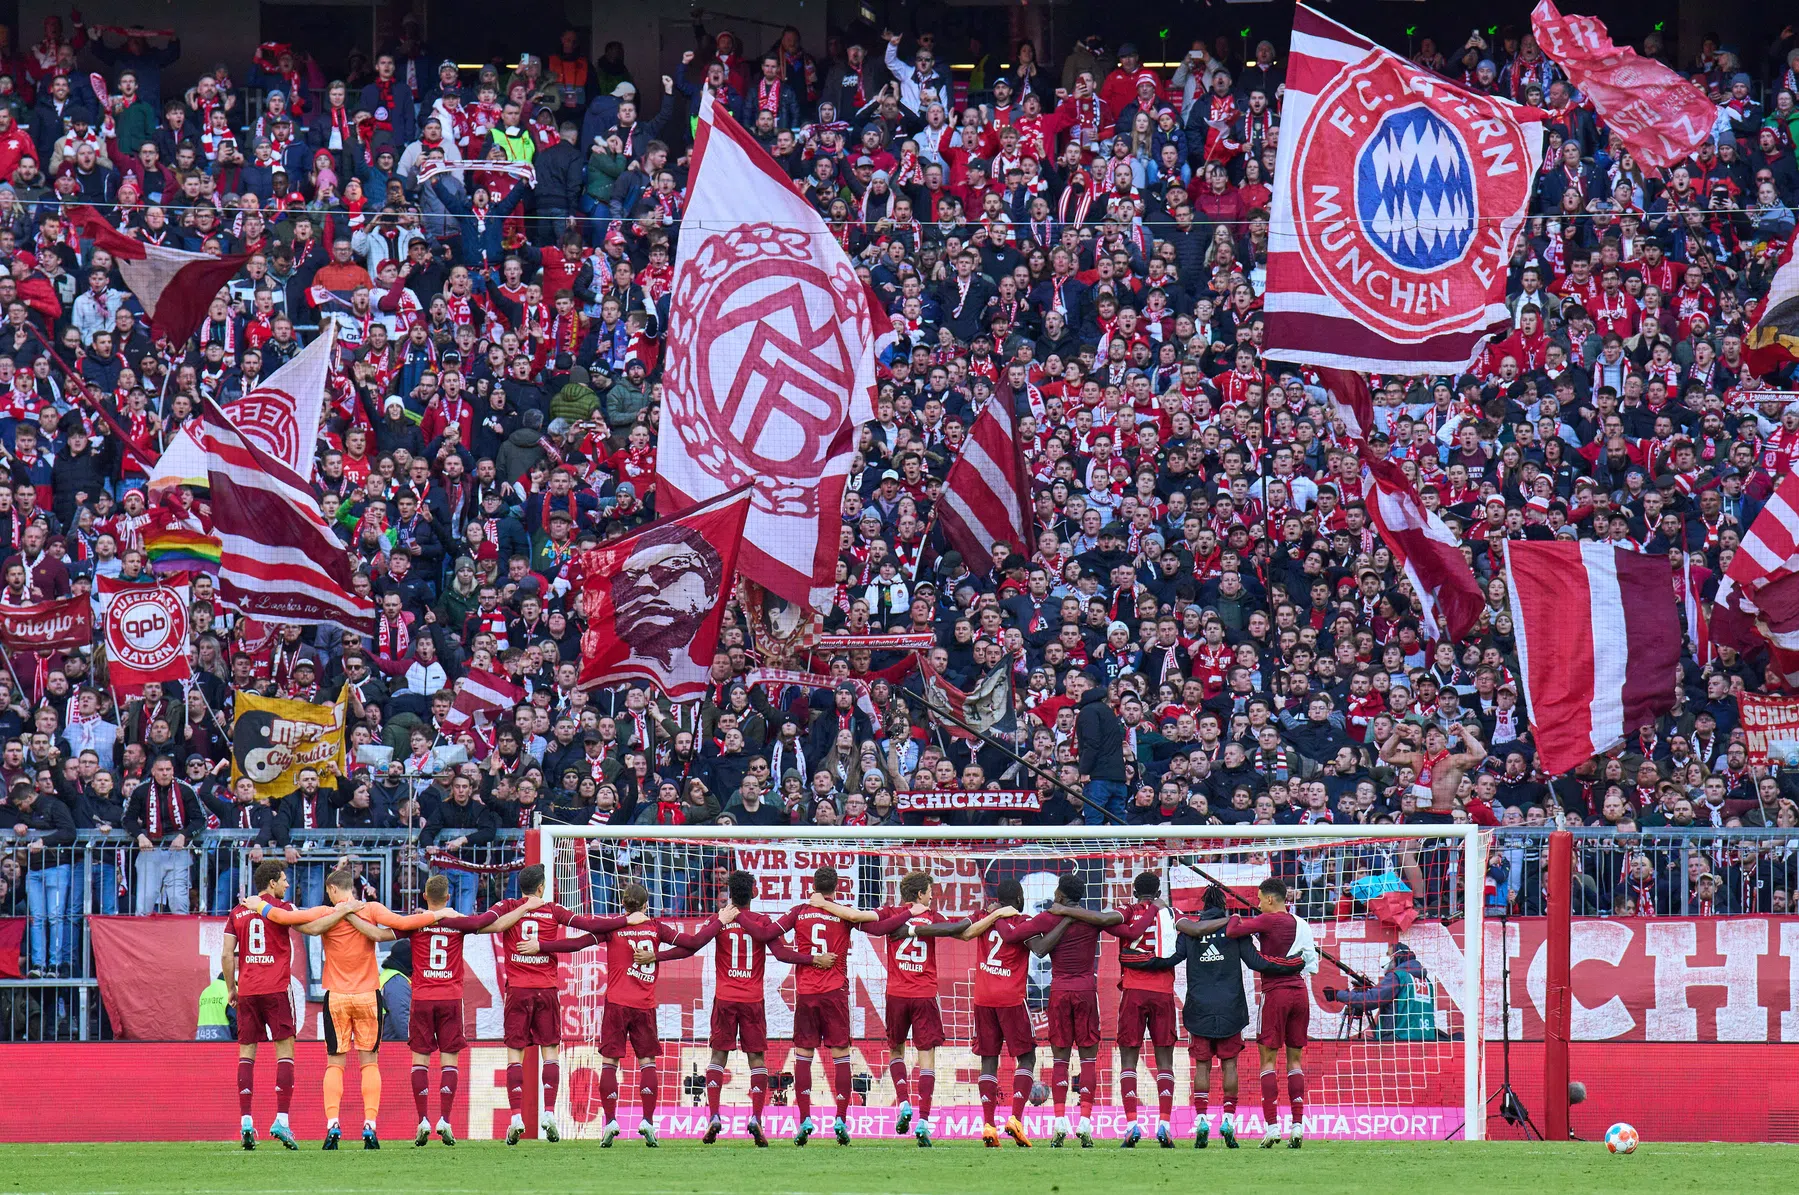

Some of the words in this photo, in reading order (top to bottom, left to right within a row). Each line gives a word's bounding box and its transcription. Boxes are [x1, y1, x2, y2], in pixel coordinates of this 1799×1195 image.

[1312, 185, 1450, 315] MÜNCHEN
[113, 592, 178, 619] QUEERPASS
[125, 613, 166, 638] qpb
[121, 643, 175, 664] BAYERN
[1742, 703, 1799, 726] SCHIC
[266, 750, 294, 770] City
[897, 792, 1041, 809] SCHICKERIA
[736, 850, 788, 870] WIR
[794, 851, 855, 870] SIND
[800, 876, 855, 901] DR
[248, 918, 266, 954] 8
[810, 923, 828, 957] 5
[895, 922, 928, 964] 25
[429, 934, 449, 970] 6
[510, 953, 550, 964] LEWANDOWSKI
[729, 932, 753, 971] 11
[986, 929, 1003, 967] 2
[1199, 954, 1225, 963] adidas
[423, 969, 453, 979] KIMMICH
[626, 966, 656, 984] SABITZER
[728, 968, 752, 979] COMAN
[898, 961, 924, 973] MÜLLER
[195, 1029, 218, 1041] 1483
[669, 1115, 797, 1135] MAGETA
[809, 1115, 890, 1135] SPORT
[945, 1115, 1082, 1135] MAGNTA
[1353, 1114, 1443, 1136] SPORT
